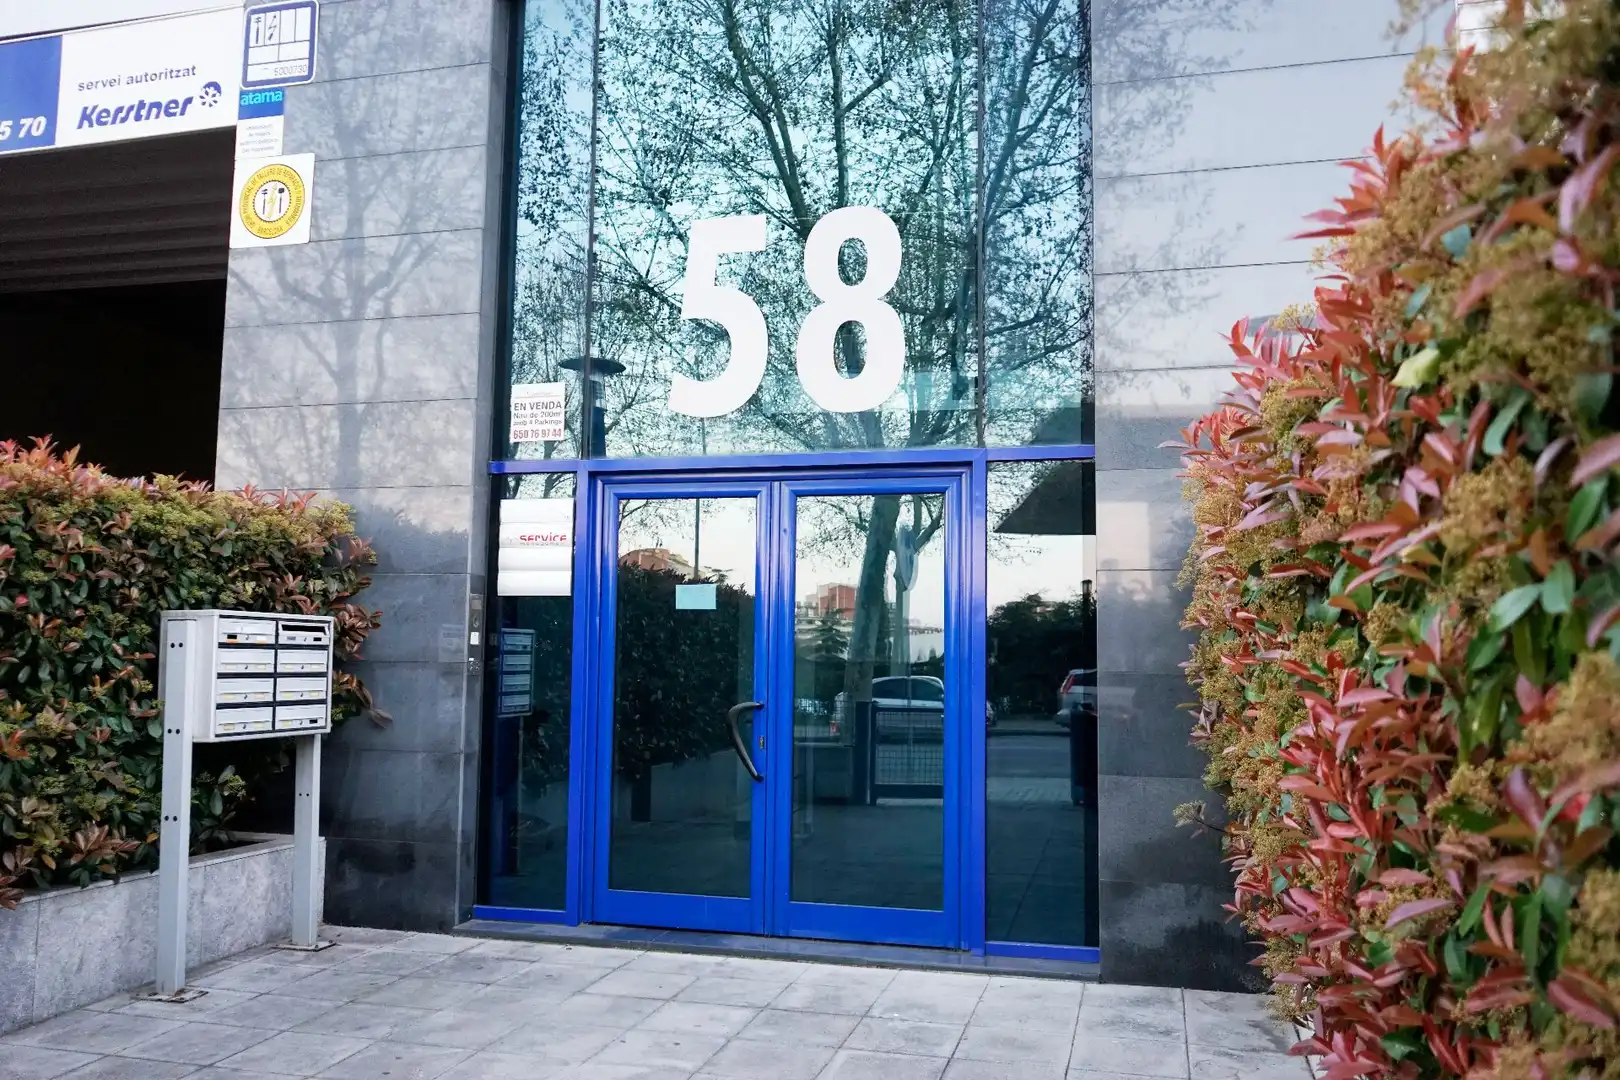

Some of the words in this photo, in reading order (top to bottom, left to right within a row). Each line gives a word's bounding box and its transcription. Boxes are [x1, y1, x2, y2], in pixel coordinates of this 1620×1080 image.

[77, 75, 122, 92] servei
[126, 65, 198, 86] autoritzat
[273, 64, 308, 77] 5000730
[240, 90, 283, 106] atama
[76, 95, 194, 130] Kerstner
[18, 116, 47, 138] 70
[668, 205, 906, 418] 58
[513, 402, 527, 412] EN
[529, 400, 562, 411] VENDA
[529, 411, 539, 419] de
[513, 429, 529, 440] 650
[530, 429, 540, 439] 76
